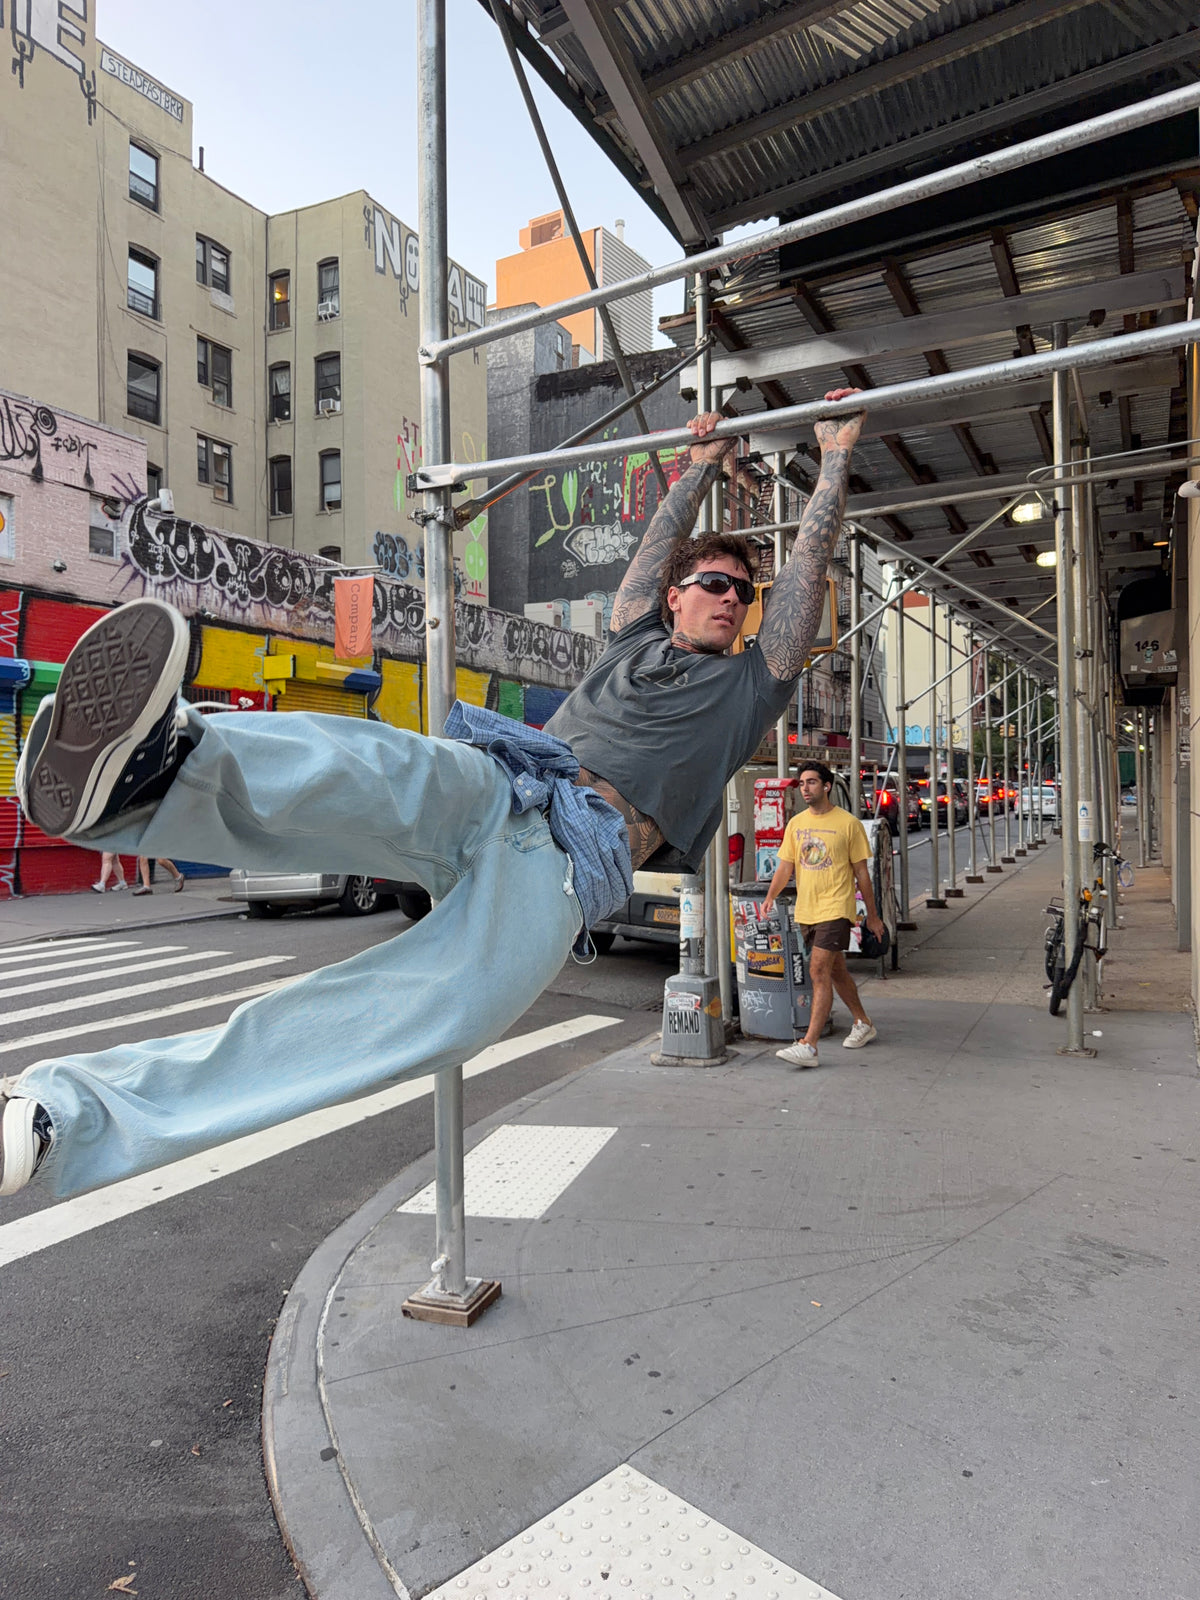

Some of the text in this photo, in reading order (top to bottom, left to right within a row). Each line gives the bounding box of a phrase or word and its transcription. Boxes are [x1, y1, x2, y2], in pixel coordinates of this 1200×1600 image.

[346, 583, 361, 654] Company
[1134, 640, 1160, 652] 146
[668, 1011, 700, 1034] REMAND
